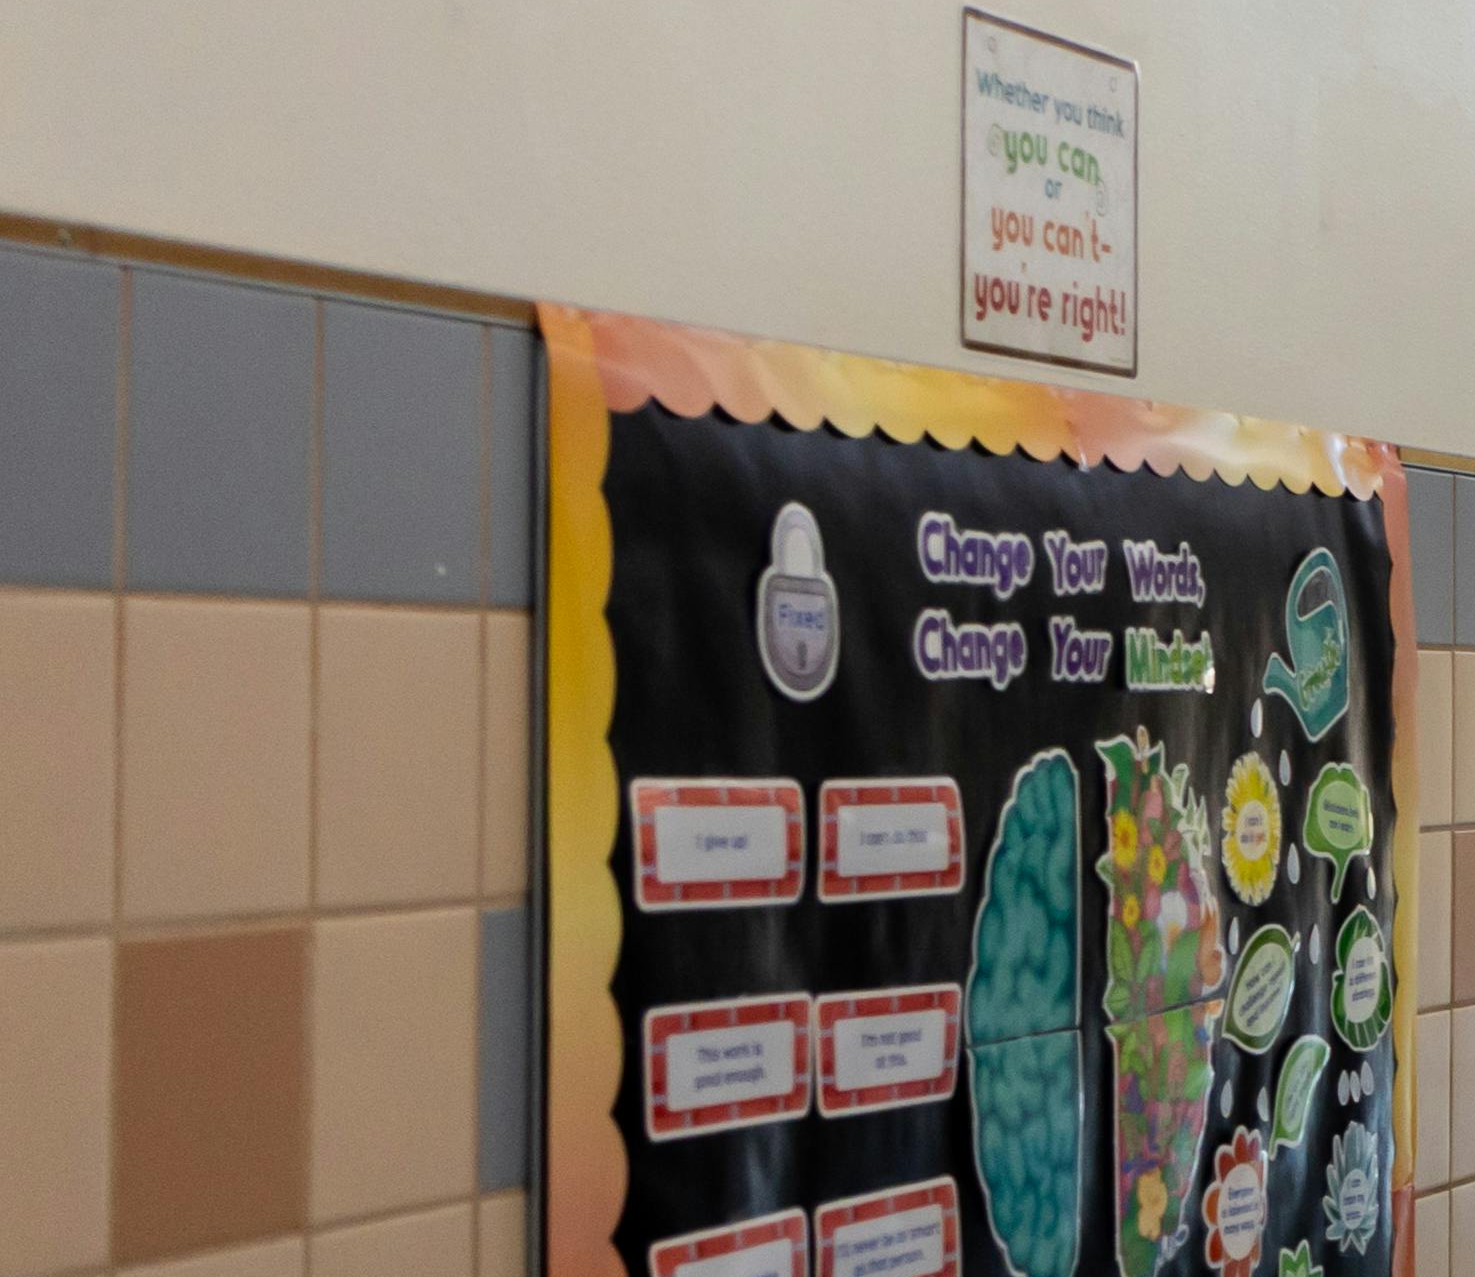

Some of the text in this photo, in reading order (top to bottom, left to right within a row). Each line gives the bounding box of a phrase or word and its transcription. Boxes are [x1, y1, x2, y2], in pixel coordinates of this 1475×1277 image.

[975, 68, 1124, 139] Whether you think
[1003, 129, 1101, 186] you can
[1044, 178, 1063, 199] or
[991, 206, 1034, 251] you
[973, 261, 1126, 342] you're right!
[920, 515, 1205, 607] Change Your Words,
[779, 603, 824, 631] Fixed
[916, 612, 1213, 691] Change Your Mindset
